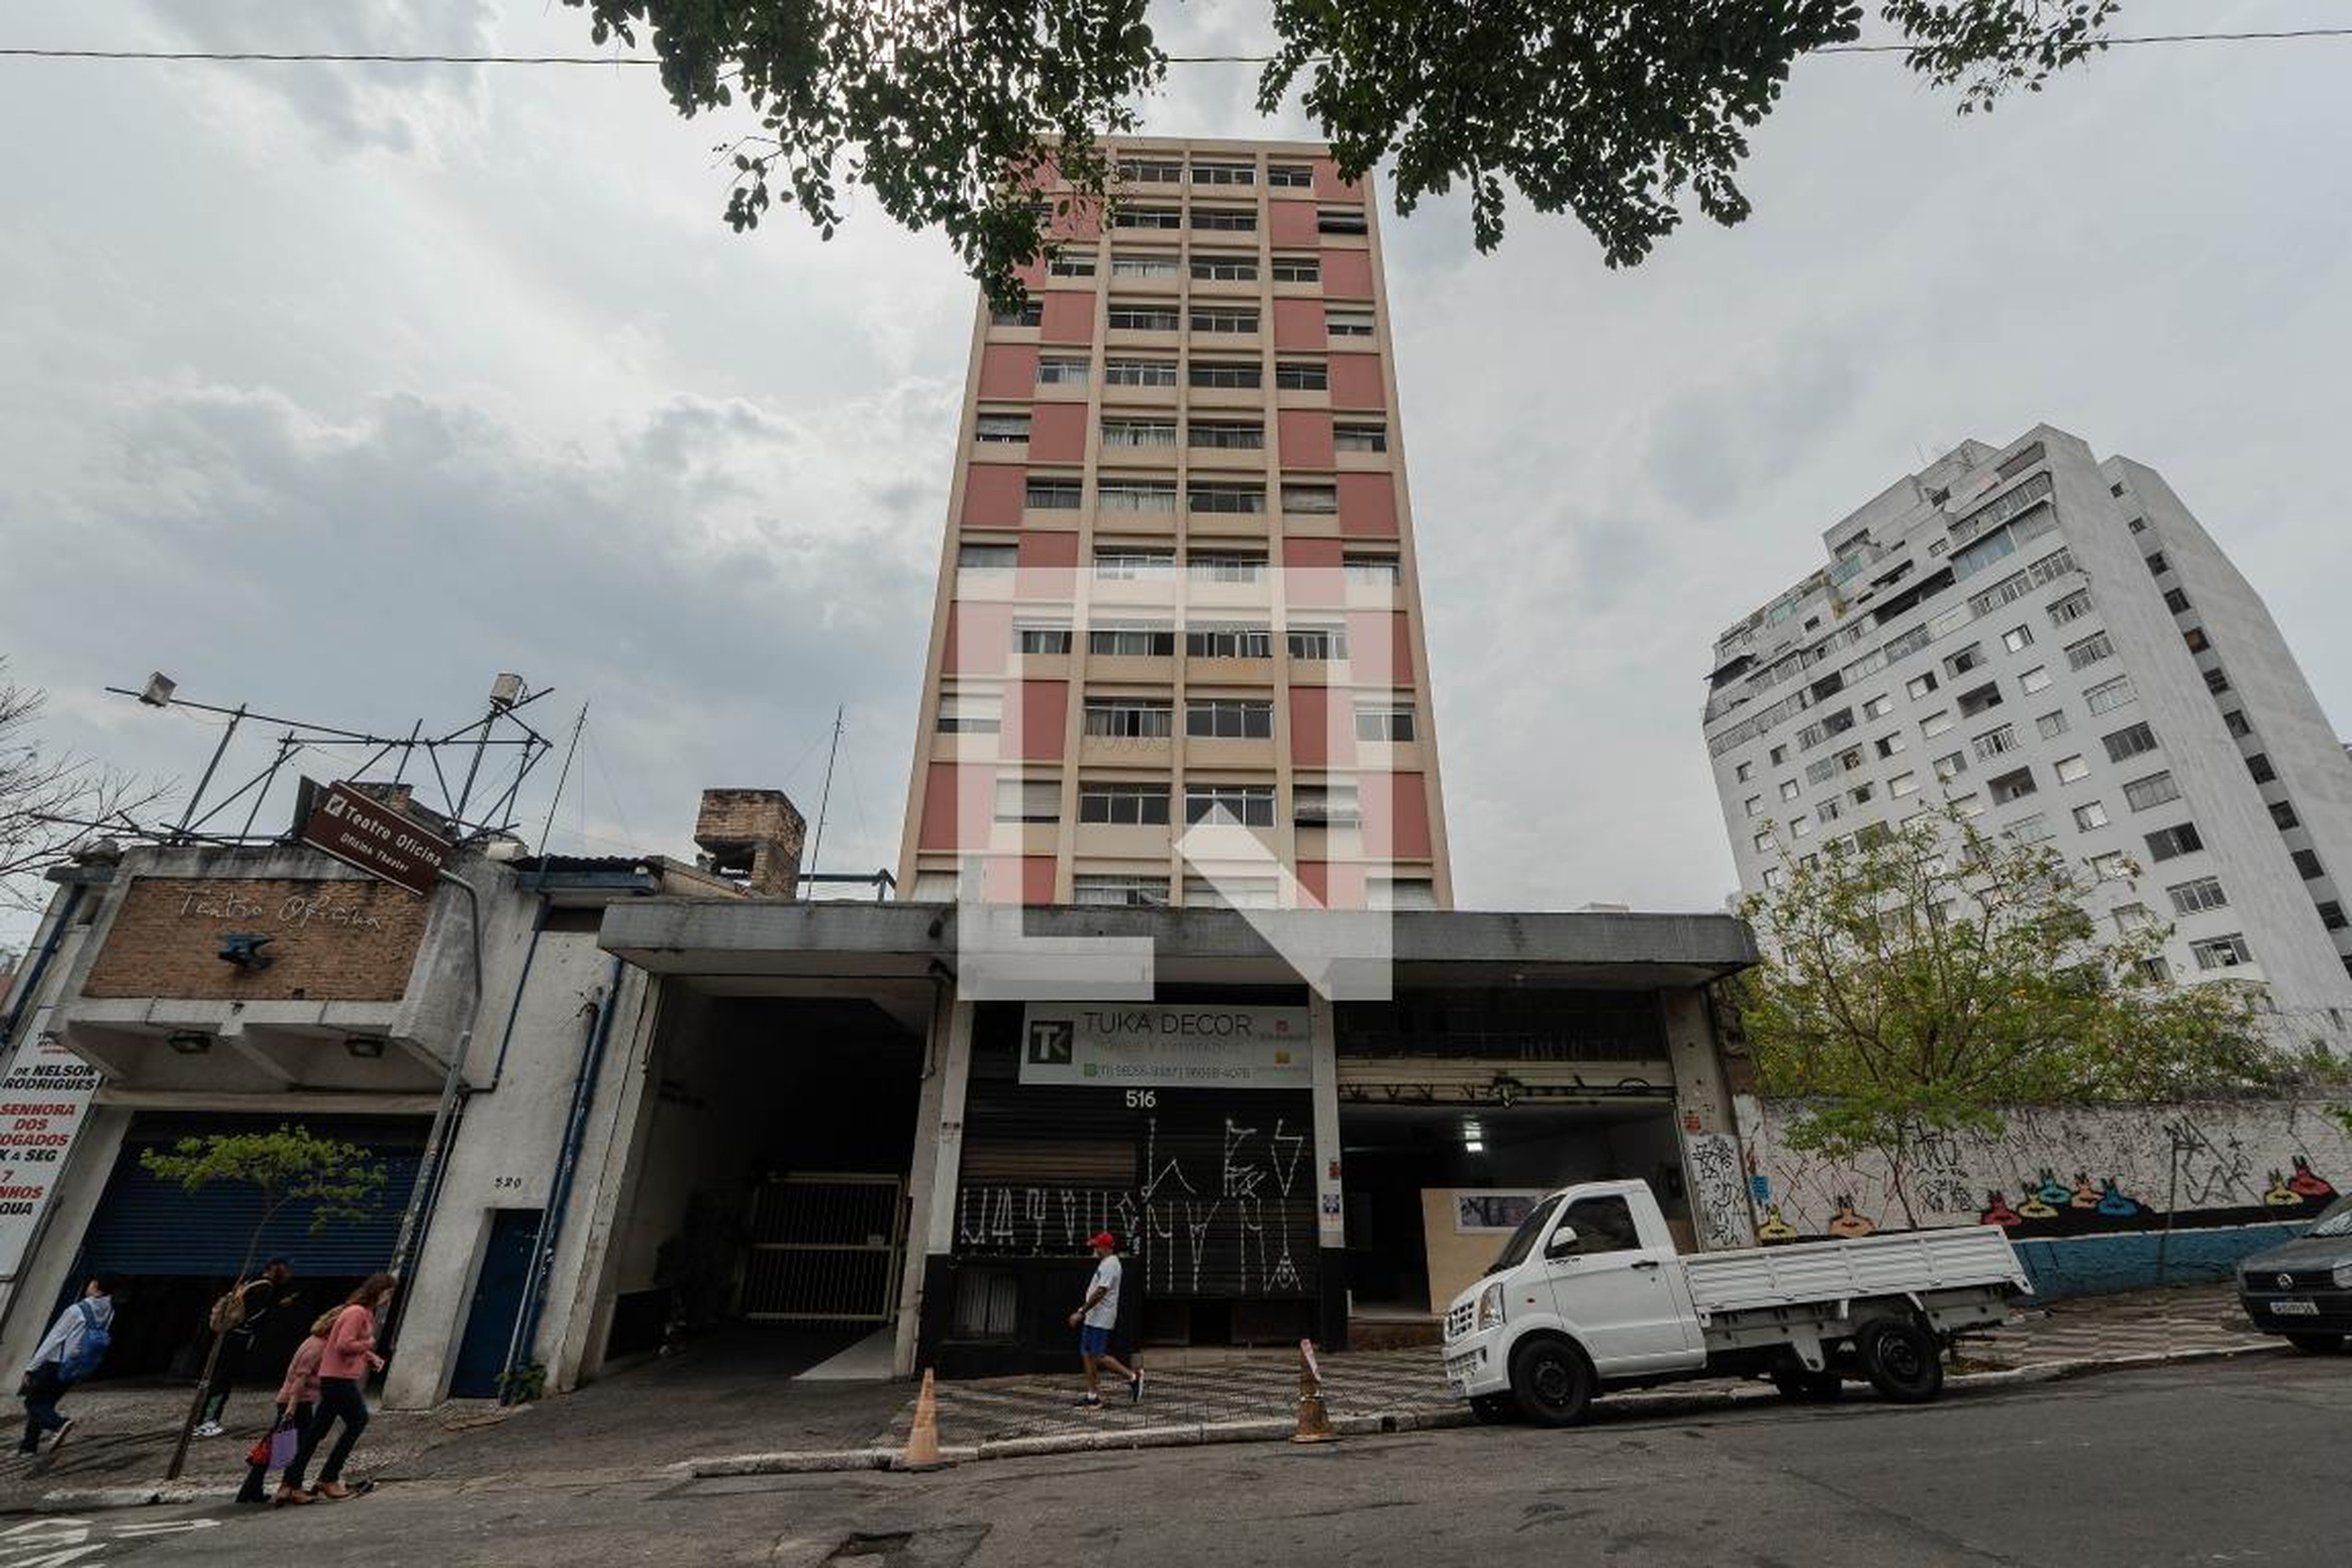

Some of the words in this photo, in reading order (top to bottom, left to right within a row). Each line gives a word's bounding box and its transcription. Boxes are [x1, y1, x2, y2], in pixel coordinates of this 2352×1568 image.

[345, 805, 391, 840] Teatro
[396, 834, 443, 867] Oficina
[1084, 1012, 1153, 1033] TUKA
[1161, 1014, 1253, 1036] DECOR
[32, 1065, 96, 1077] NELSON
[2, 1077, 96, 1091] RODRIGUES
[1126, 1090, 1157, 1108] 516
[0, 1103, 76, 1115] SENHORA
[13, 1118, 48, 1131] DOS
[24, 1149, 58, 1162] SEG
[2, 1170, 14, 1183] 7
[494, 1176, 522, 1189] 520
